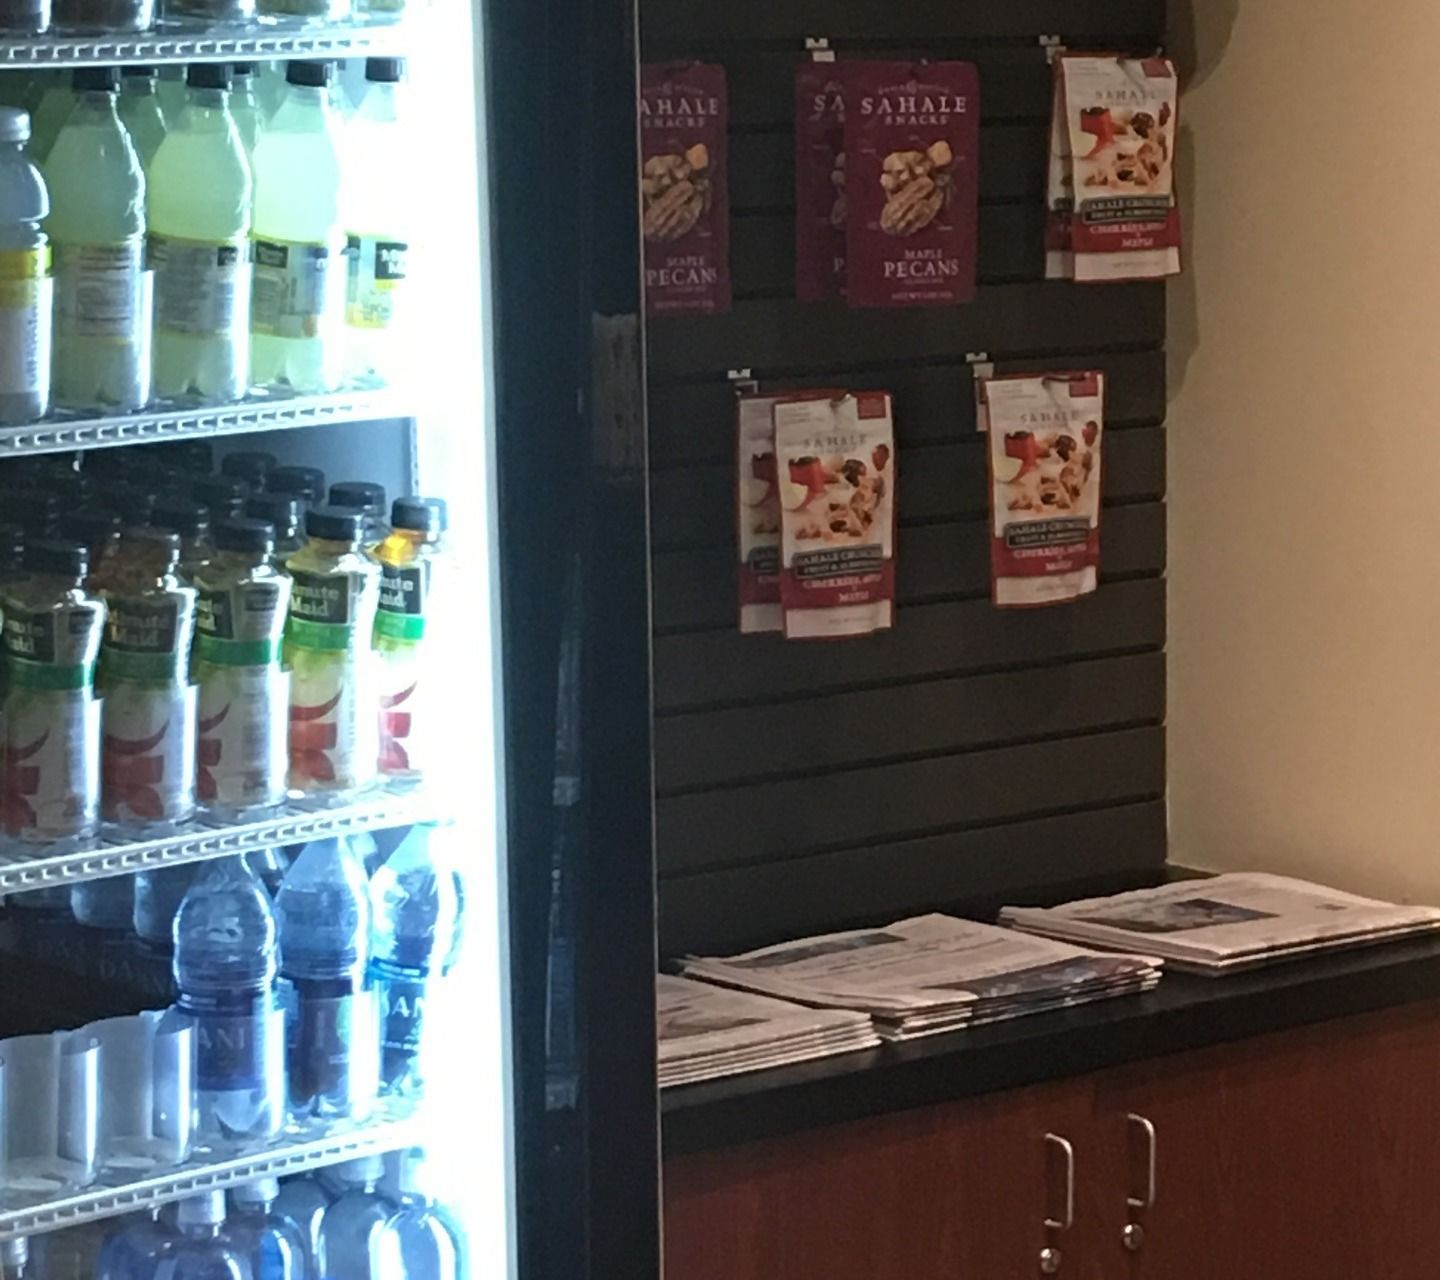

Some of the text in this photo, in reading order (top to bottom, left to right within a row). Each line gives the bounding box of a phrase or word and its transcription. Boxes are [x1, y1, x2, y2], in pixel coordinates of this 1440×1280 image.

[639, 97, 719, 116] AHALE
[860, 96, 967, 114] SAHALE
[883, 258, 960, 278] PECANS
